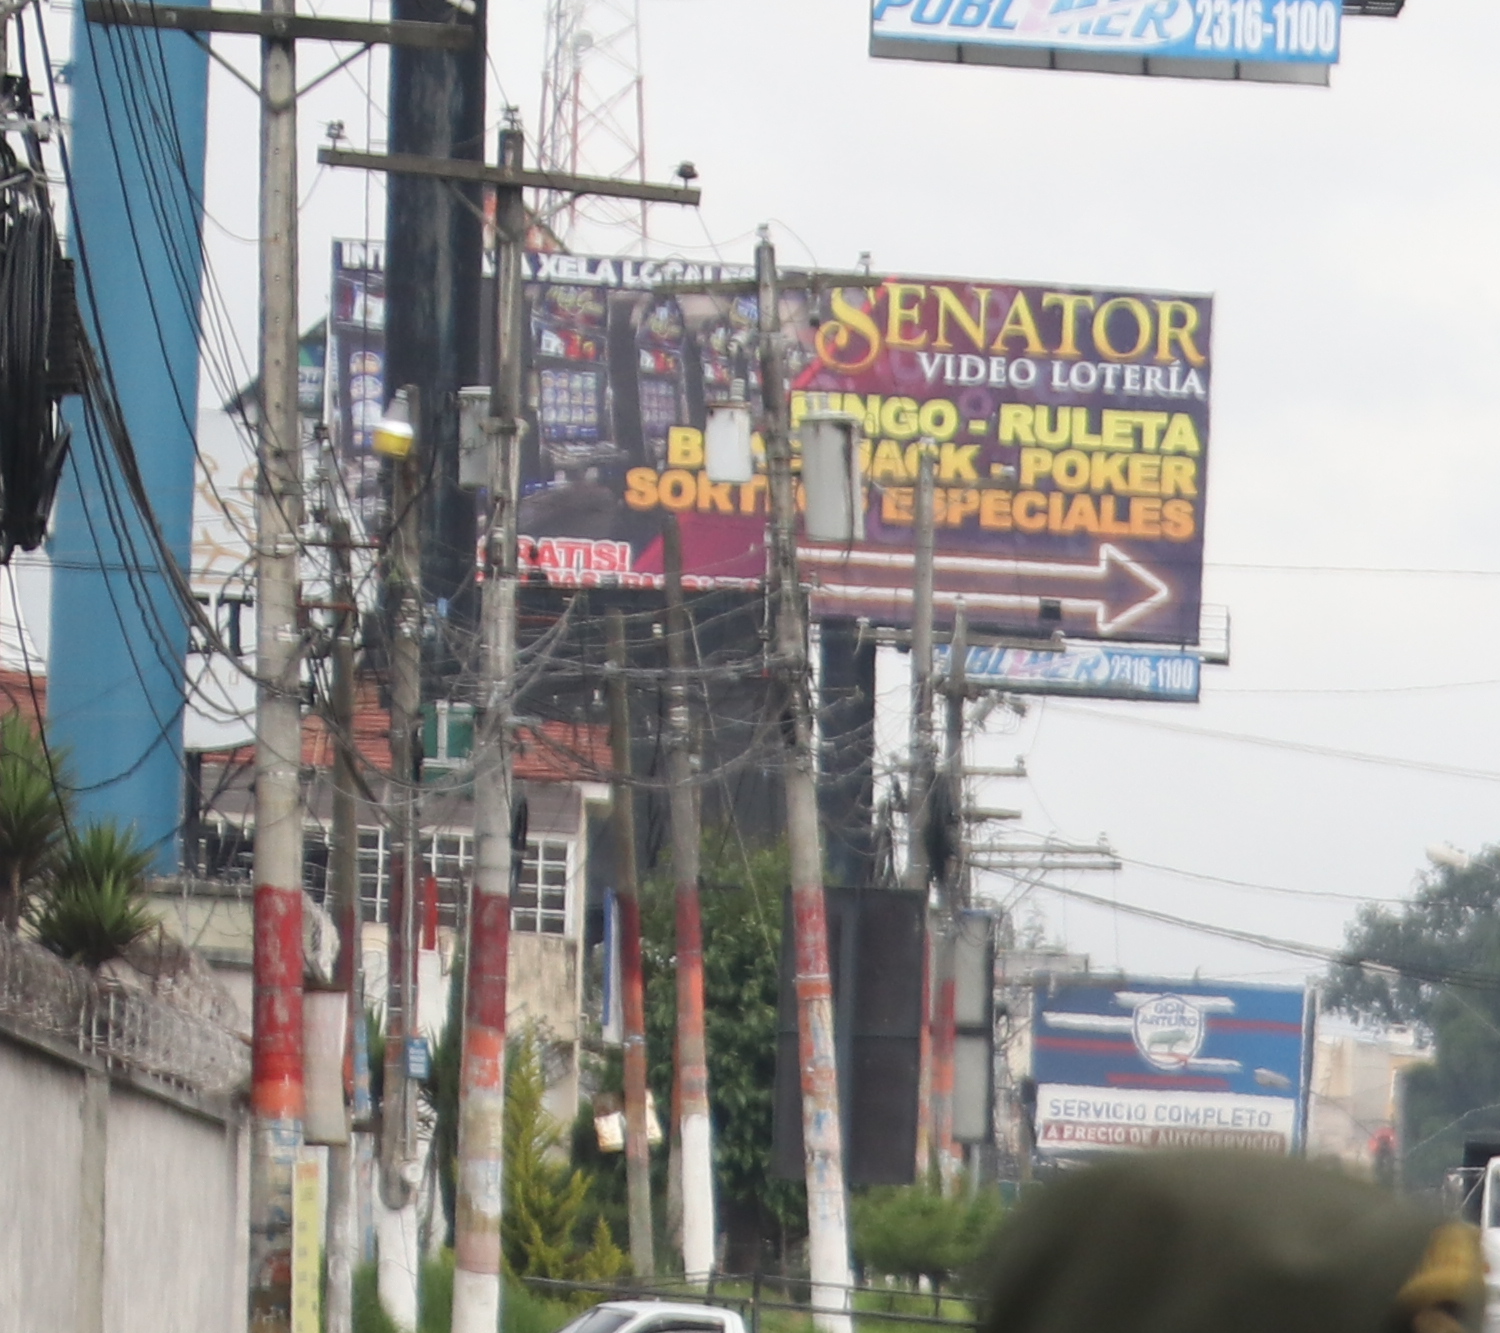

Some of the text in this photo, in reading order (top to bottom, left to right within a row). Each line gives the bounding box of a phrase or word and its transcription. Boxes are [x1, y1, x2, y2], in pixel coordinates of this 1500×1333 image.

[1194, 1, 1336, 54] 2316-1100
[537, 252, 617, 286] XELA
[815, 284, 1205, 372] SENATOR
[917, 352, 1206, 396] VIDEO LOTERÍA
[1000, 403, 1200, 452] RULETA
[1020, 447, 1197, 496] POKER
[476, 535, 631, 572] RATIS!
[1110, 656, 1193, 690] 2316-1100
[1047, 1125, 1058, 1140] A
[1050, 1099, 1271, 1127] SERVICIO COMPLETO
